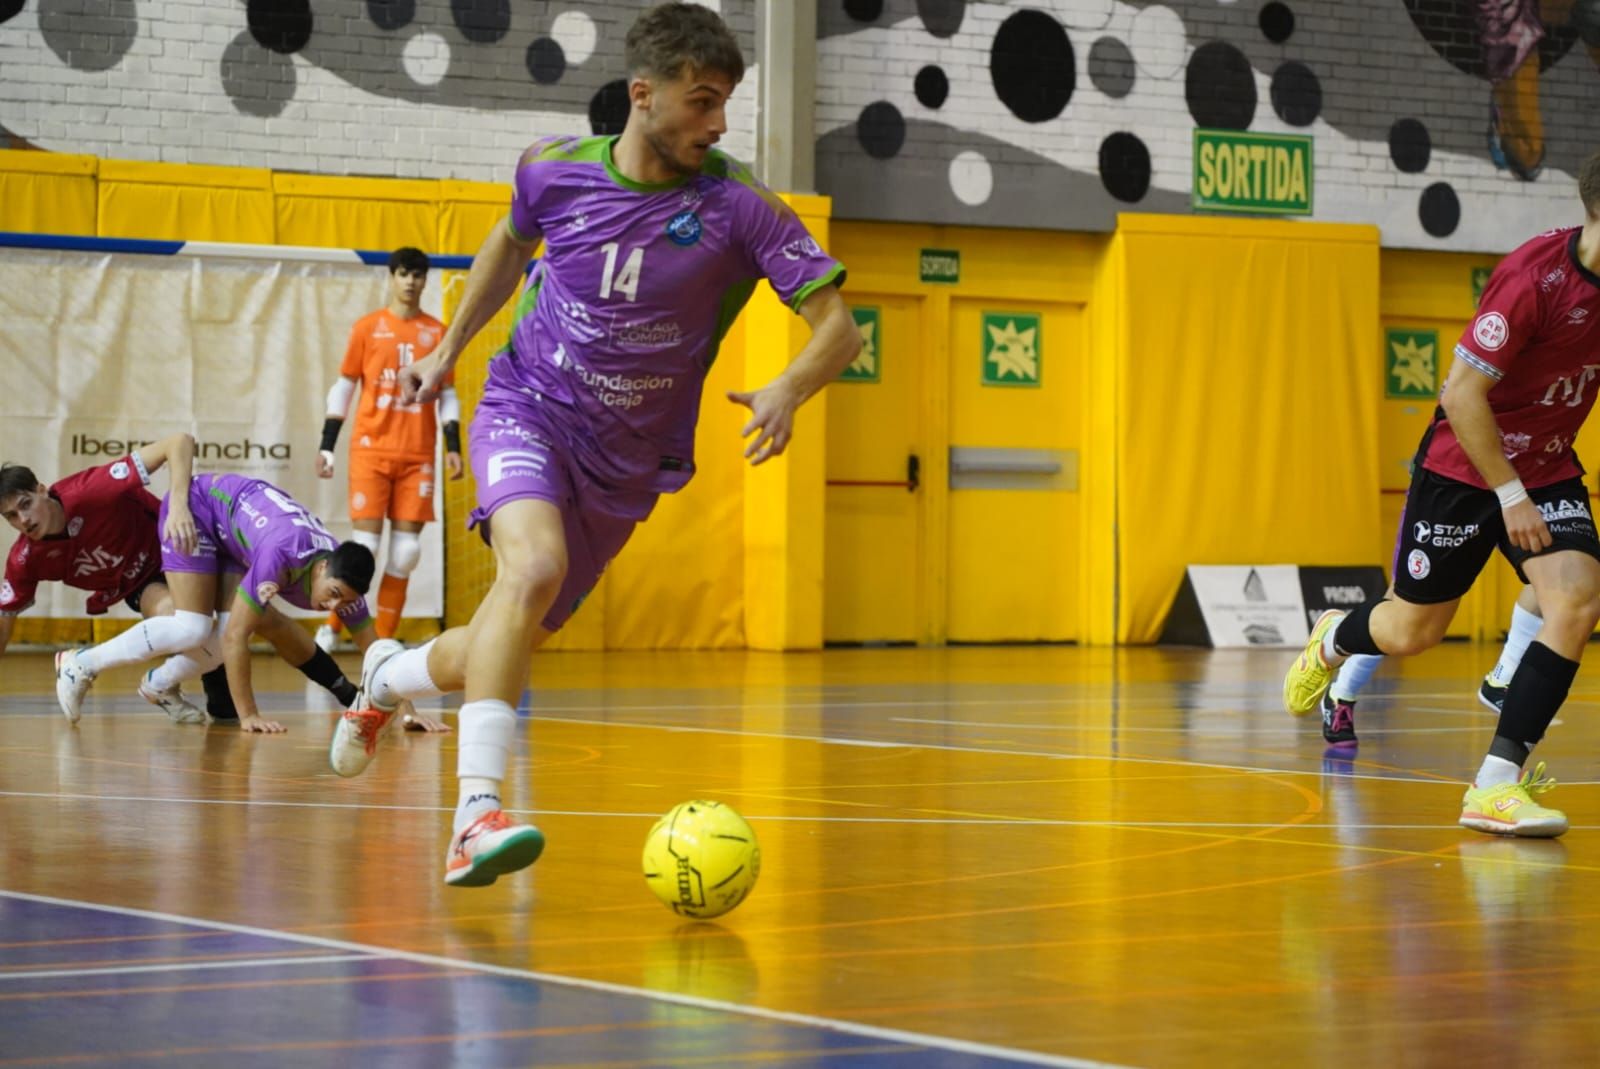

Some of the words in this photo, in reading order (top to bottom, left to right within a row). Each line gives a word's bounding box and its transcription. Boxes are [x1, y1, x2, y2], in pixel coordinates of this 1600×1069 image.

[1199, 141, 1306, 202] SORTIDA
[599, 242, 644, 302] 14
[597, 389, 643, 410] icaja
[72, 434, 291, 460] Iberncha
[1432, 535, 1475, 548] GRO
